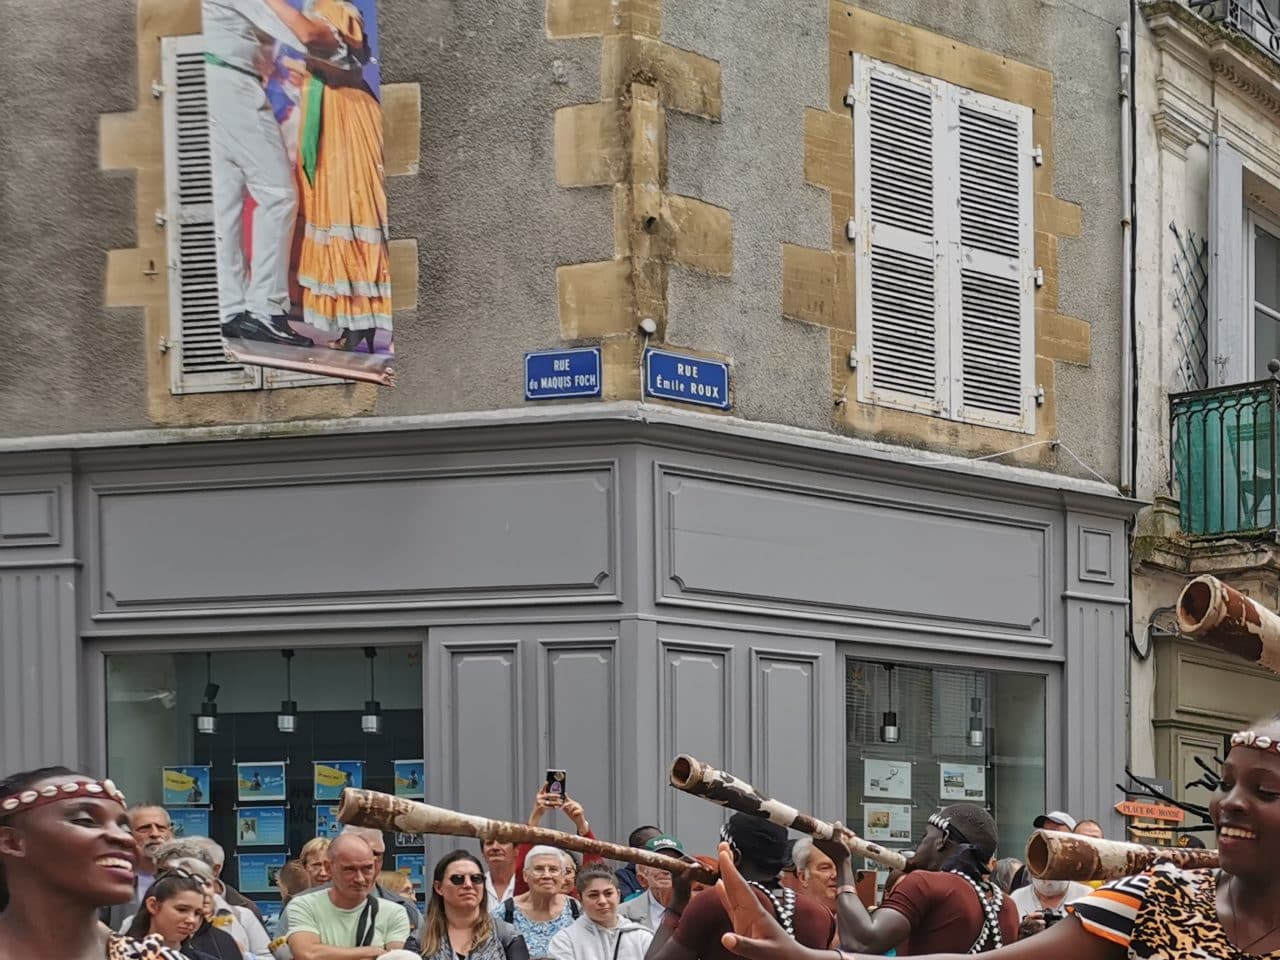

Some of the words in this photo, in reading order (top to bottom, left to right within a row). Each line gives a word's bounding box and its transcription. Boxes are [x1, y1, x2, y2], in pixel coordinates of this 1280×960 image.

[553, 359, 570, 371] RUE
[677, 363, 698, 378] RUE
[529, 378, 538, 390] du
[541, 375, 571, 389] MAQUIS
[574, 374, 596, 387] FOCH
[656, 374, 685, 392] Émile
[690, 382, 719, 399] ROUX
